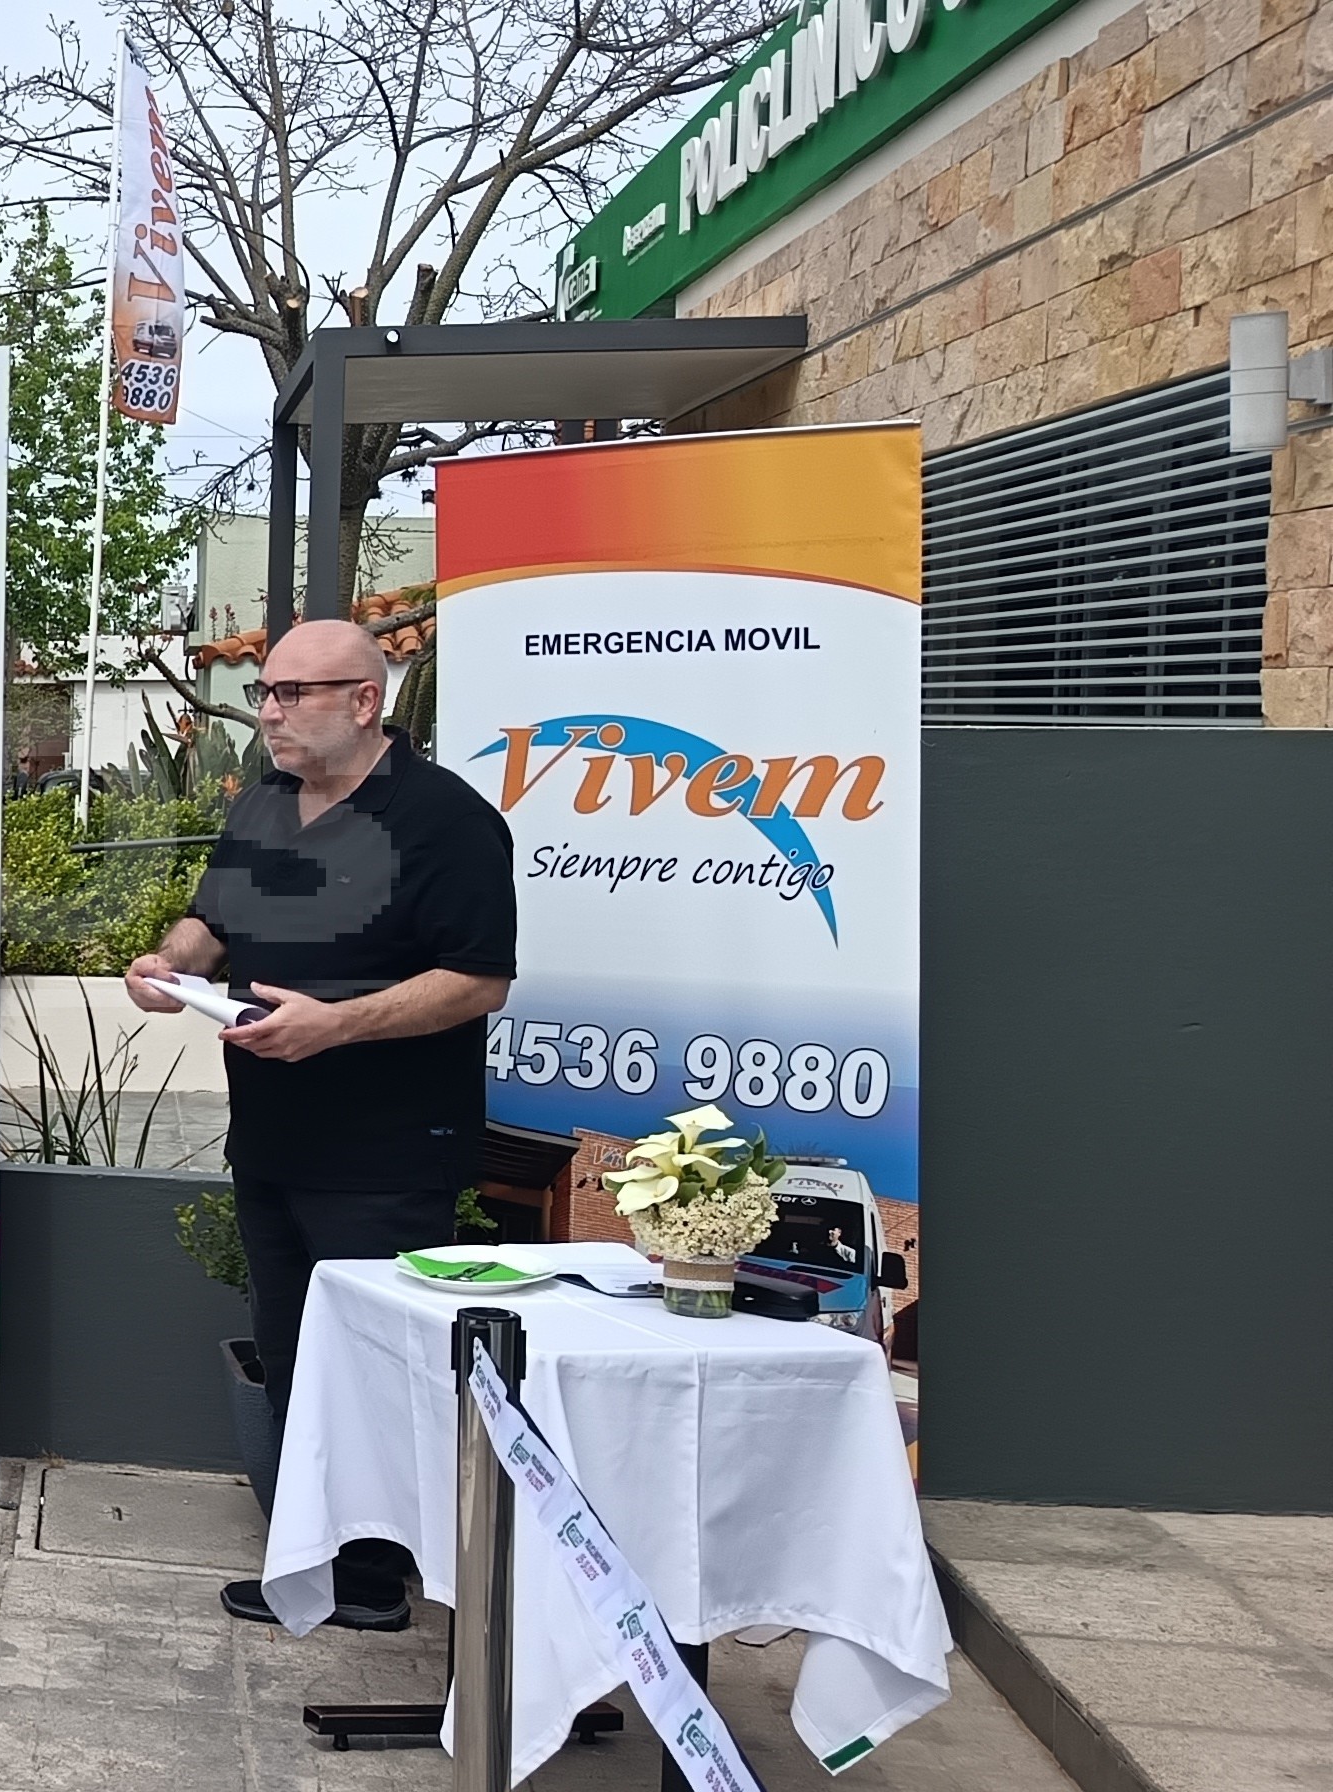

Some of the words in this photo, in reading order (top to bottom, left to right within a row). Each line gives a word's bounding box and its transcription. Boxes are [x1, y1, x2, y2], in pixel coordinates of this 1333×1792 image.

[121, 362, 177, 388] 4536
[524, 629, 716, 657] EMERGENCIA
[724, 626, 821, 652] MOVIL
[496, 720, 887, 824] Vivem
[527, 842, 678, 897] Siempre
[693, 851, 836, 901] contigo
[485, 1016, 659, 1095] 4536
[683, 1032, 891, 1120] 9880
